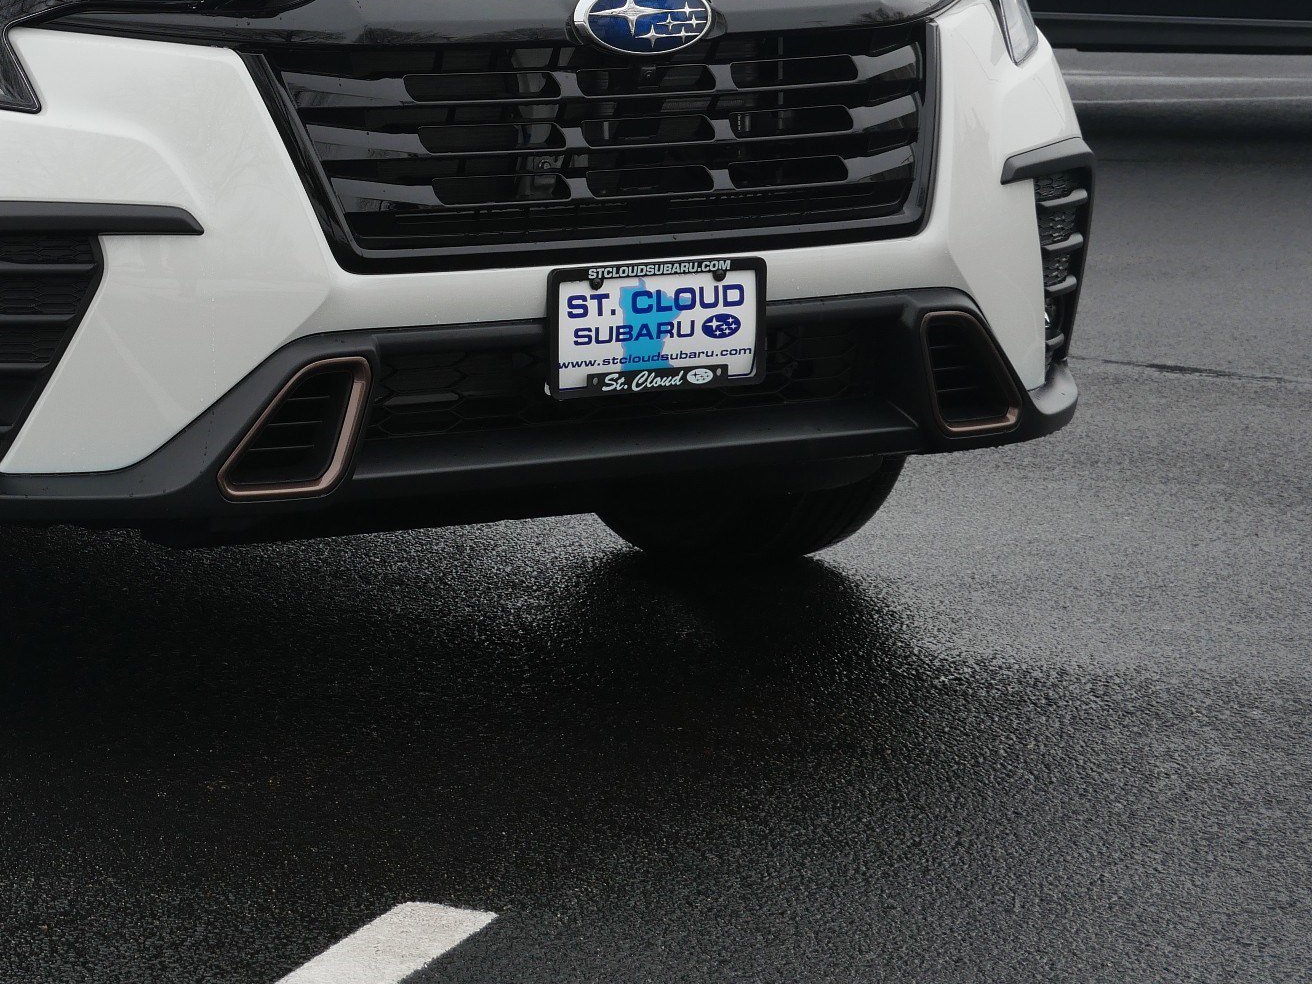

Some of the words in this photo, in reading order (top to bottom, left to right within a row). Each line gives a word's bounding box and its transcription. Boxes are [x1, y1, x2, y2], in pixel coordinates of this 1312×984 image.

[588, 260, 731, 279] STCLOUDSUBARU.COM
[567, 293, 616, 319] ST.
[631, 283, 745, 315] CLOUD
[573, 320, 695, 346] SUBARU
[558, 347, 752, 369] www.stcloudsubaru.com
[602, 373, 628, 391] St.
[632, 371, 684, 392] Cloud
